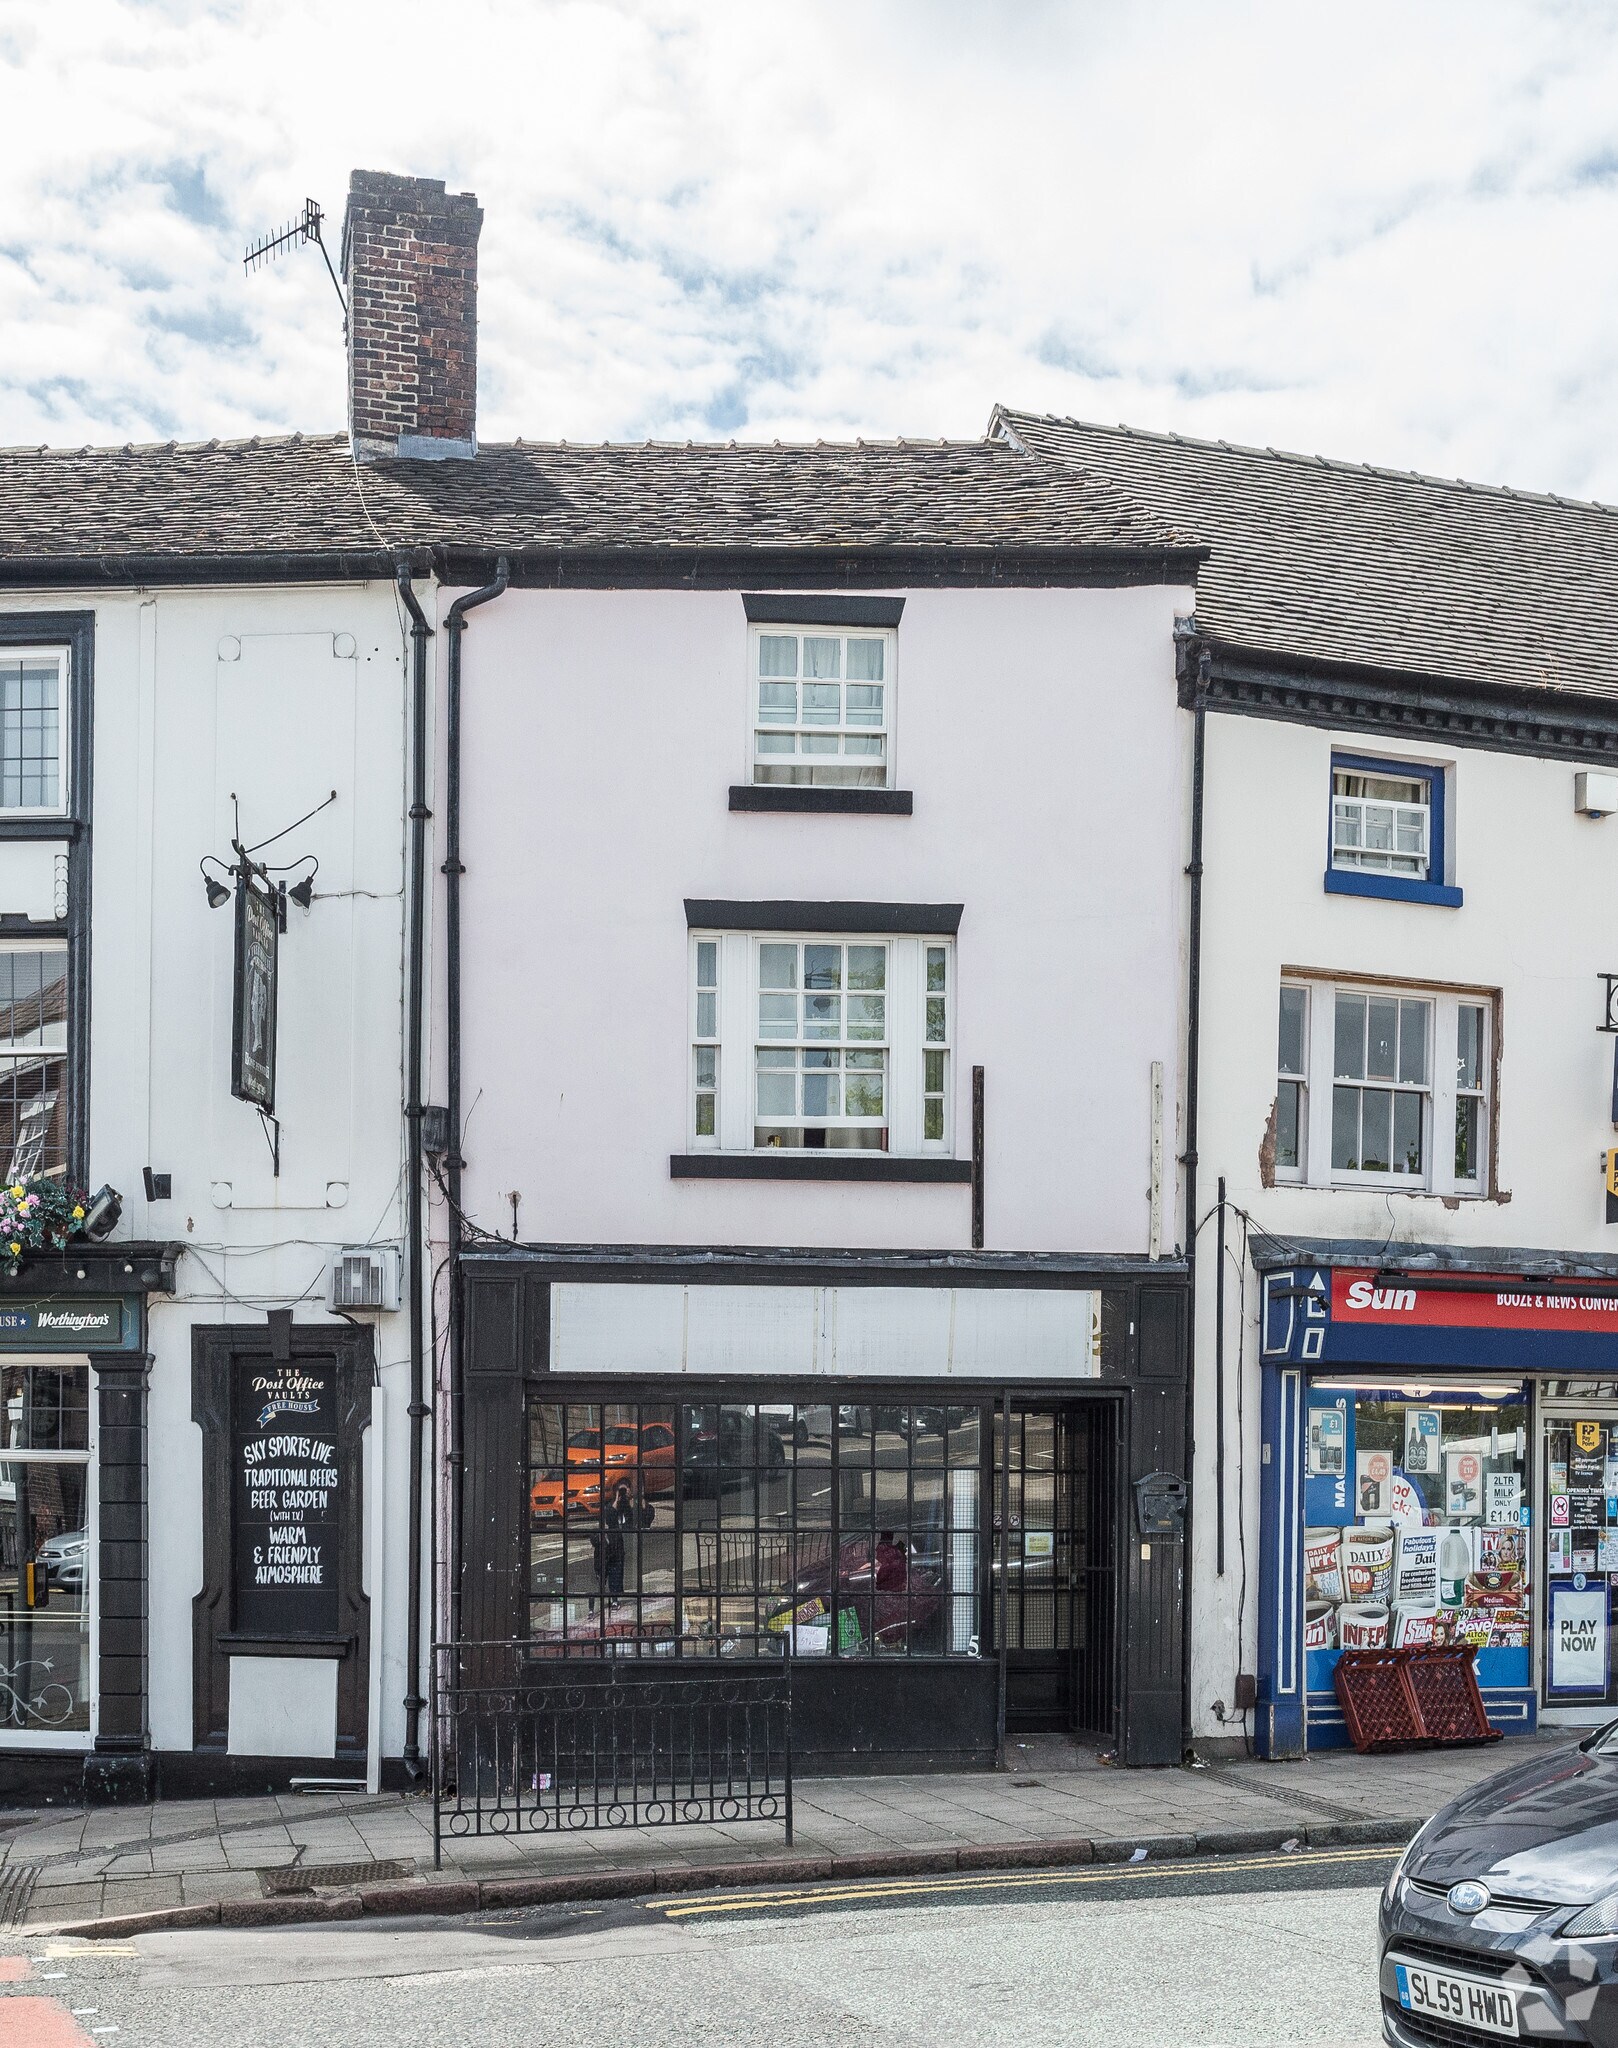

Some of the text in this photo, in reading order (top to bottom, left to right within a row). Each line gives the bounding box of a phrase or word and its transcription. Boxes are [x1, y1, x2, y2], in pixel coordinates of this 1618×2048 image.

[1345, 1282, 1417, 1311] Sun
[1497, 1293, 1532, 1307] BOOZE
[1535, 1295, 1544, 1308] &
[1546, 1295, 1577, 1310] NEWS
[0, 1312, 110, 1331] USE Worthington's
[277, 1369, 300, 1377] THE
[252, 1377, 325, 1392] Post Office
[267, 1391, 310, 1399] VAULTS
[267, 1402, 313, 1413] FREE HOUSE
[1329, 1420, 1339, 1429] £1
[244, 1435, 335, 1465] SKY SPORTS LIVE
[244, 1468, 338, 1488] TRADITIONAL BEERS
[1493, 1476, 1514, 1485] 2LTR
[251, 1490, 328, 1509] BEER GARDEN
[1493, 1489, 1514, 1497] MILK
[1494, 1499, 1512, 1507] ONLY
[270, 1510, 290, 1522] (WITH
[1490, 1511, 1519, 1523] £1.10
[269, 1526, 306, 1545] WARM
[1404, 1537, 1431, 1546] Fabulous
[1403, 1543, 1433, 1552] holidays
[1482, 1537, 1499, 1551] TV
[253, 1546, 322, 1565] & FRIENDLY
[1308, 1547, 1328, 1557] DAILY
[1349, 1548, 1385, 1563] DAILY
[1415, 1552, 1436, 1565] Dail
[255, 1566, 324, 1584] ATMOSPHERE
[1348, 1568, 1370, 1584] 10p
[1404, 1620, 1433, 1644] STAR
[1455, 1619, 1492, 1638] Reve
[1560, 1620, 1598, 1635] PLAY
[967, 1635, 979, 1658] 5
[1560, 1637, 1597, 1652] NOW
[1410, 1973, 1514, 2028] SL59 HWD
